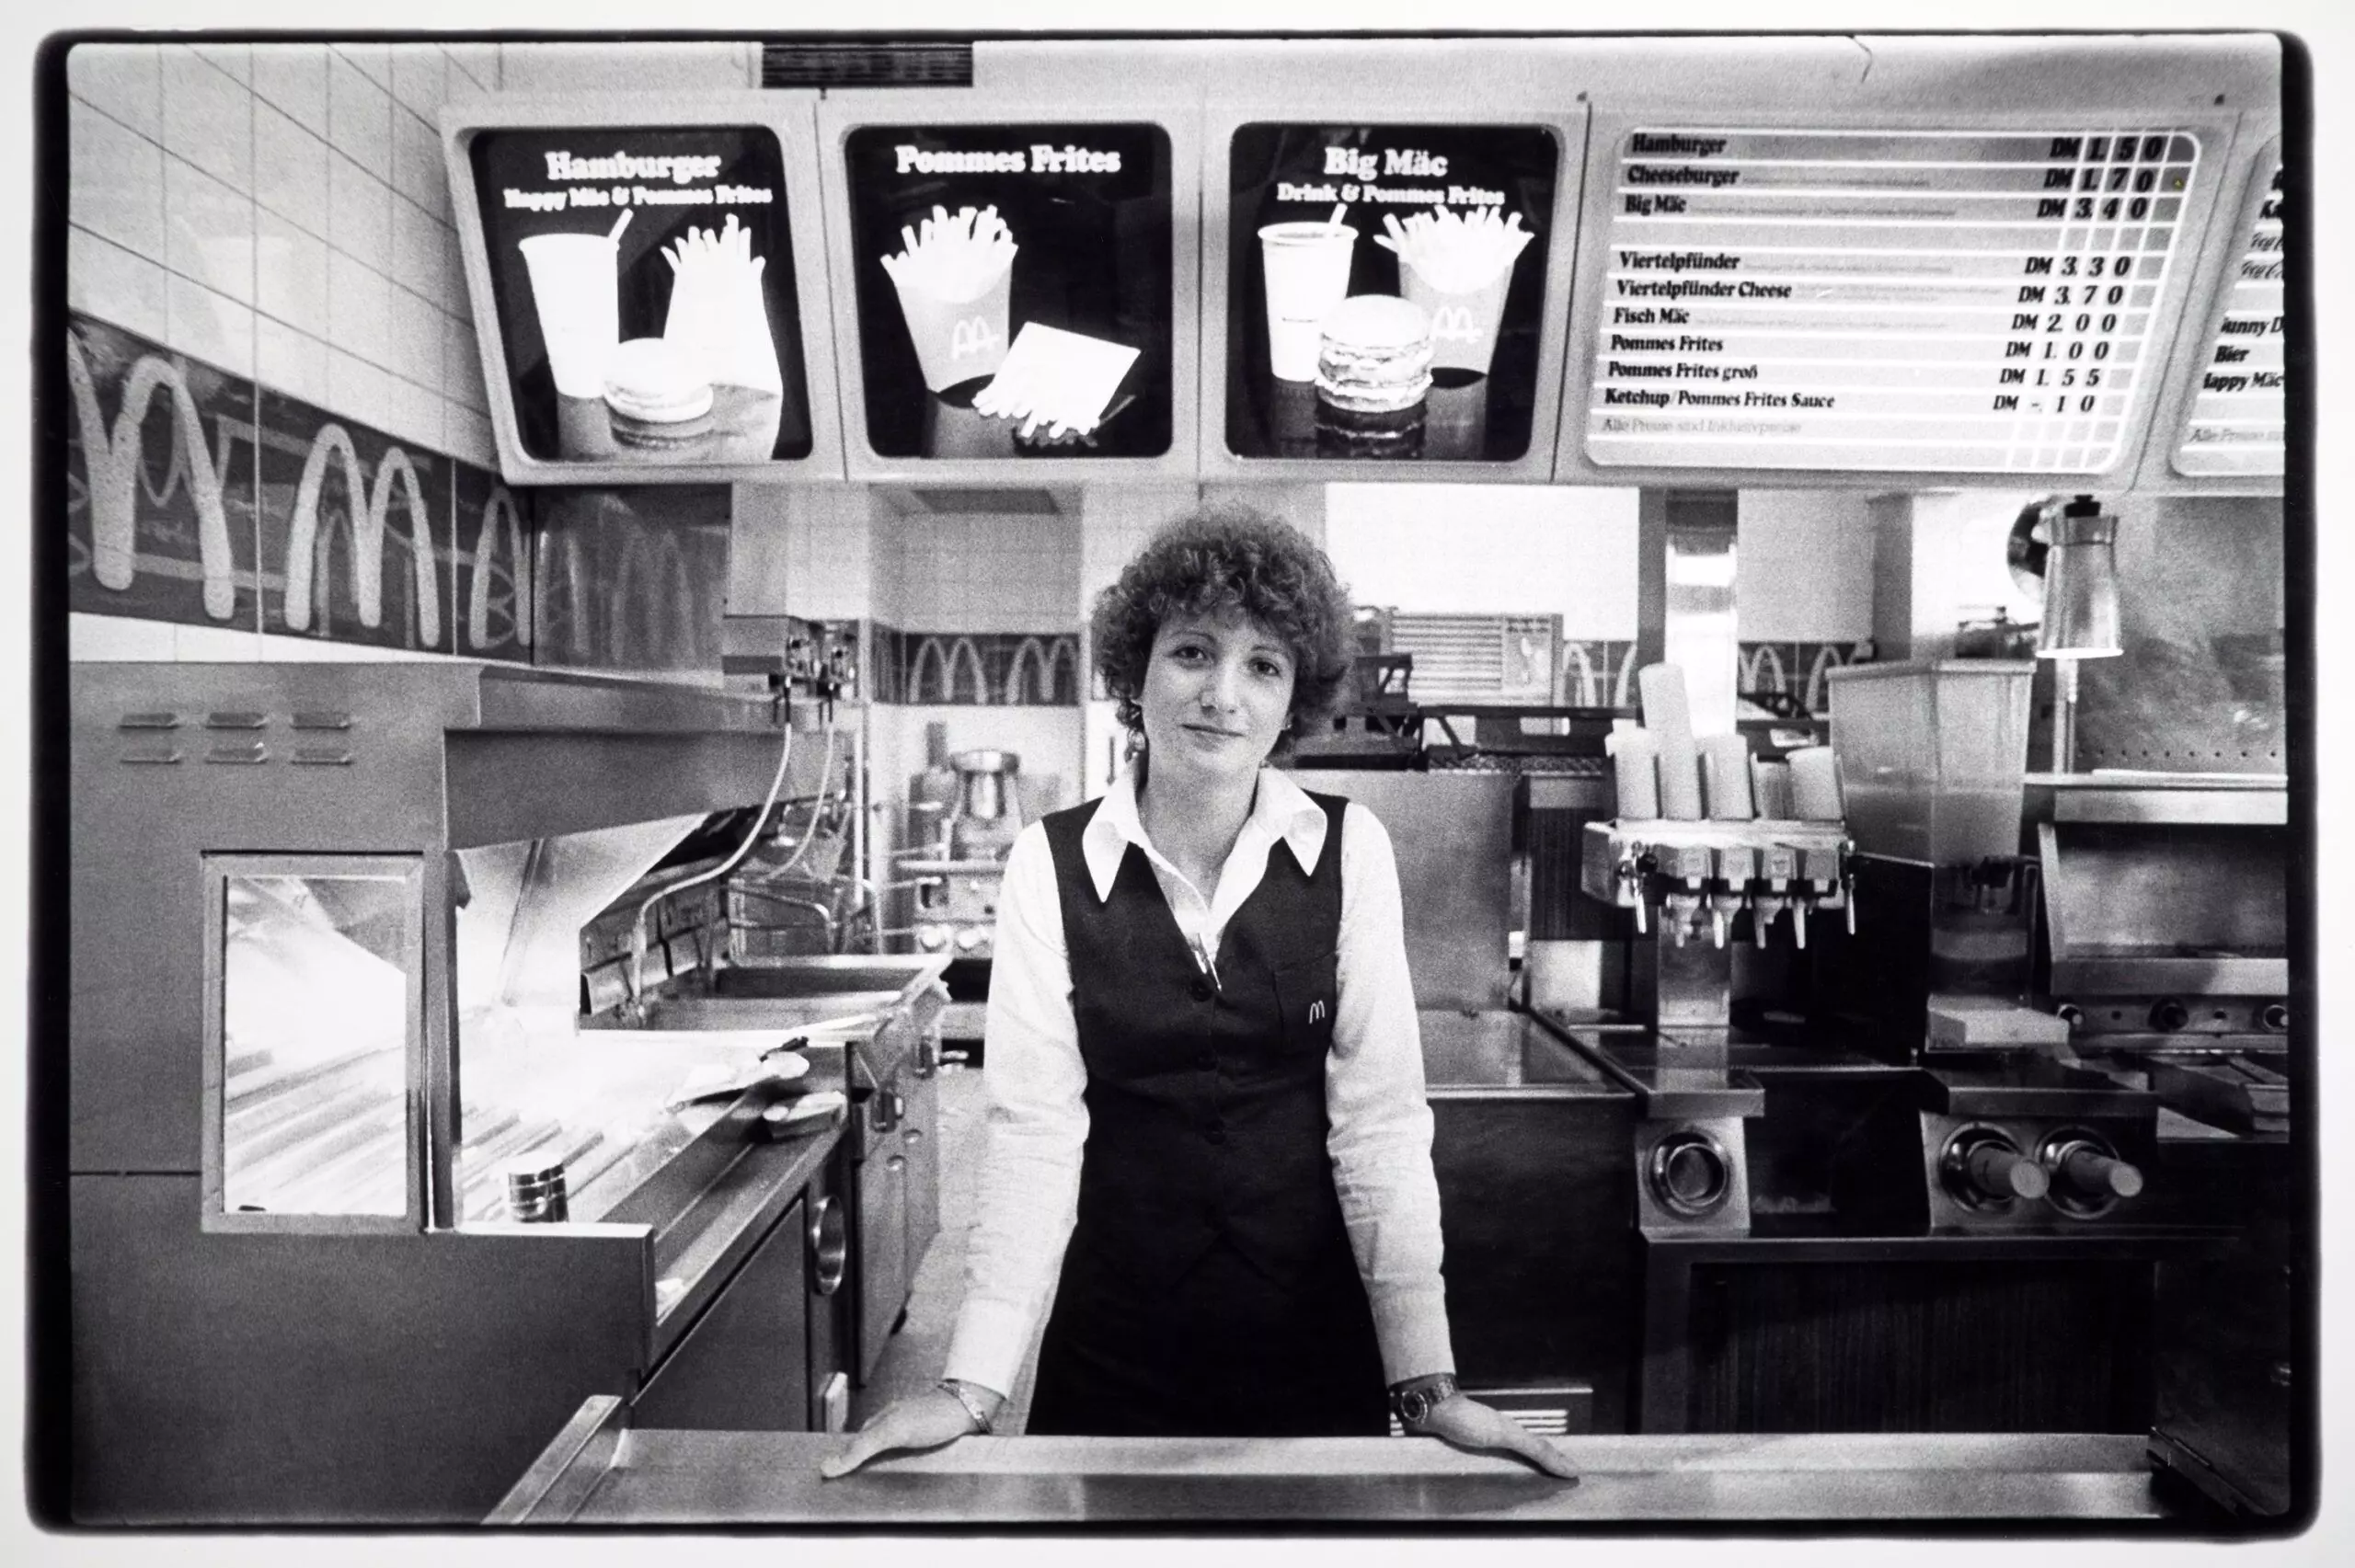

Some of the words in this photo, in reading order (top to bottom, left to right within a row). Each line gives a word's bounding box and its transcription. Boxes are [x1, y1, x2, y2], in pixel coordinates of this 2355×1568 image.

[1632, 133, 1727, 157] Hamburger
[2050, 136, 2081, 158] DM
[545, 151, 722, 184] Hamburger
[894, 144, 1027, 174] Pommes
[1029, 144, 1121, 173] Frites
[1323, 146, 1378, 181] Big
[1384, 148, 1448, 177] Mäc
[1627, 164, 1740, 188] Cheeseburger
[2043, 168, 2075, 188] DM
[715, 185, 773, 204] Frites
[1277, 182, 1338, 202] Drink
[1341, 183, 1360, 202] &
[1362, 184, 1445, 203] Pommes
[1447, 185, 1506, 205] Frites
[1625, 194, 1652, 216] Big
[1654, 193, 1686, 213] Mäc
[2037, 198, 2067, 218] DM
[1619, 251, 1740, 273] Viertelpfünder
[2025, 257, 2053, 274] DM
[1617, 280, 1736, 301] Viertelpfünder
[1738, 281, 1792, 299] Cheese
[2017, 286, 2046, 303] DM
[1613, 306, 1656, 325] Fisch
[1659, 307, 1690, 325] Mäc
[2012, 314, 2039, 330] DM
[1611, 334, 1675, 351] Pommes
[1679, 336, 1723, 352] Frites
[2005, 341, 2032, 358] DM
[2214, 345, 2250, 363] Bier
[1608, 361, 1672, 377] Pommes
[1675, 362, 1719, 379] Frites
[1999, 368, 2026, 384] DM
[1744, 391, 1787, 407] Frites
[1791, 393, 1835, 408] Sauce
[1993, 395, 2019, 410] DM
